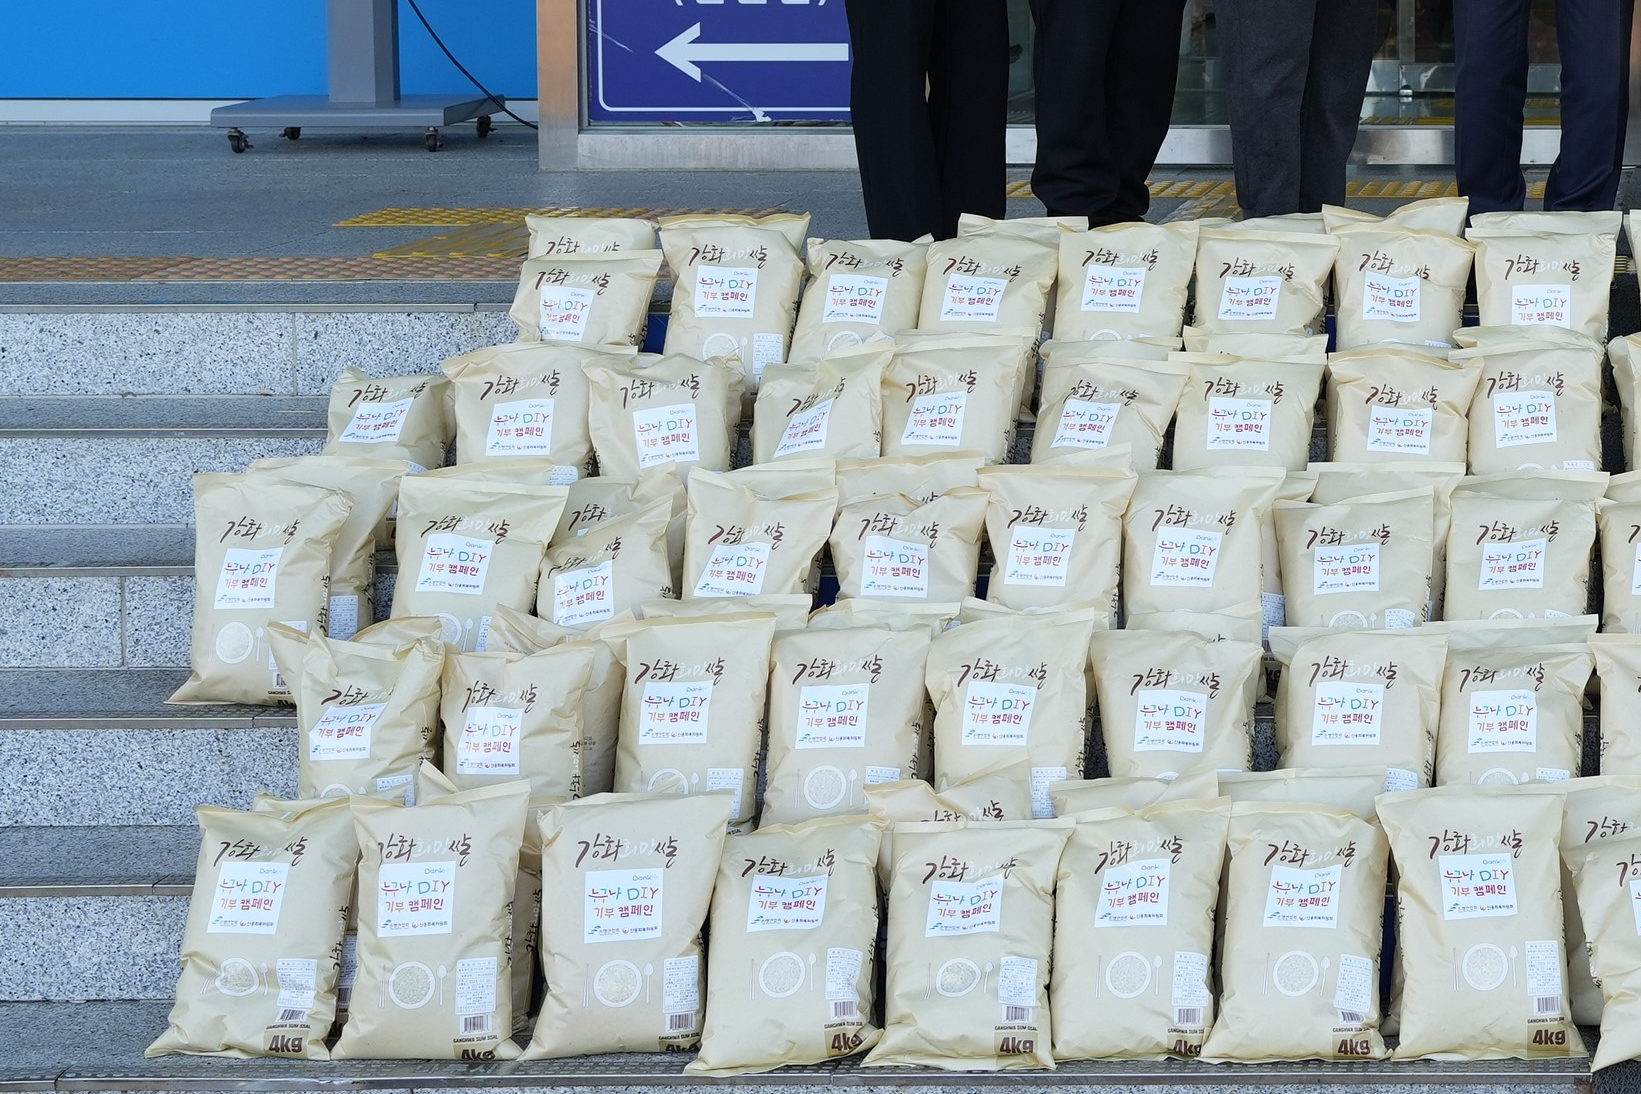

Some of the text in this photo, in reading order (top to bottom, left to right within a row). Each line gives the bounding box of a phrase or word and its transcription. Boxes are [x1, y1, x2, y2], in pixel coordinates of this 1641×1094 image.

[729, 279, 753, 290] DIY
[645, 696, 707, 709] 누구나 DIY
[669, 711, 700, 723] 캠페인
[1444, 869, 1509, 883] 누구나 DIY
[220, 878, 282, 894] 누구나 DIY
[1451, 885, 1506, 897] 기부 캠페인
[220, 898, 273, 911] 기부 캠페인
[268, 1034, 303, 1053] 4kg
[1532, 1028, 1566, 1046] 4kg
